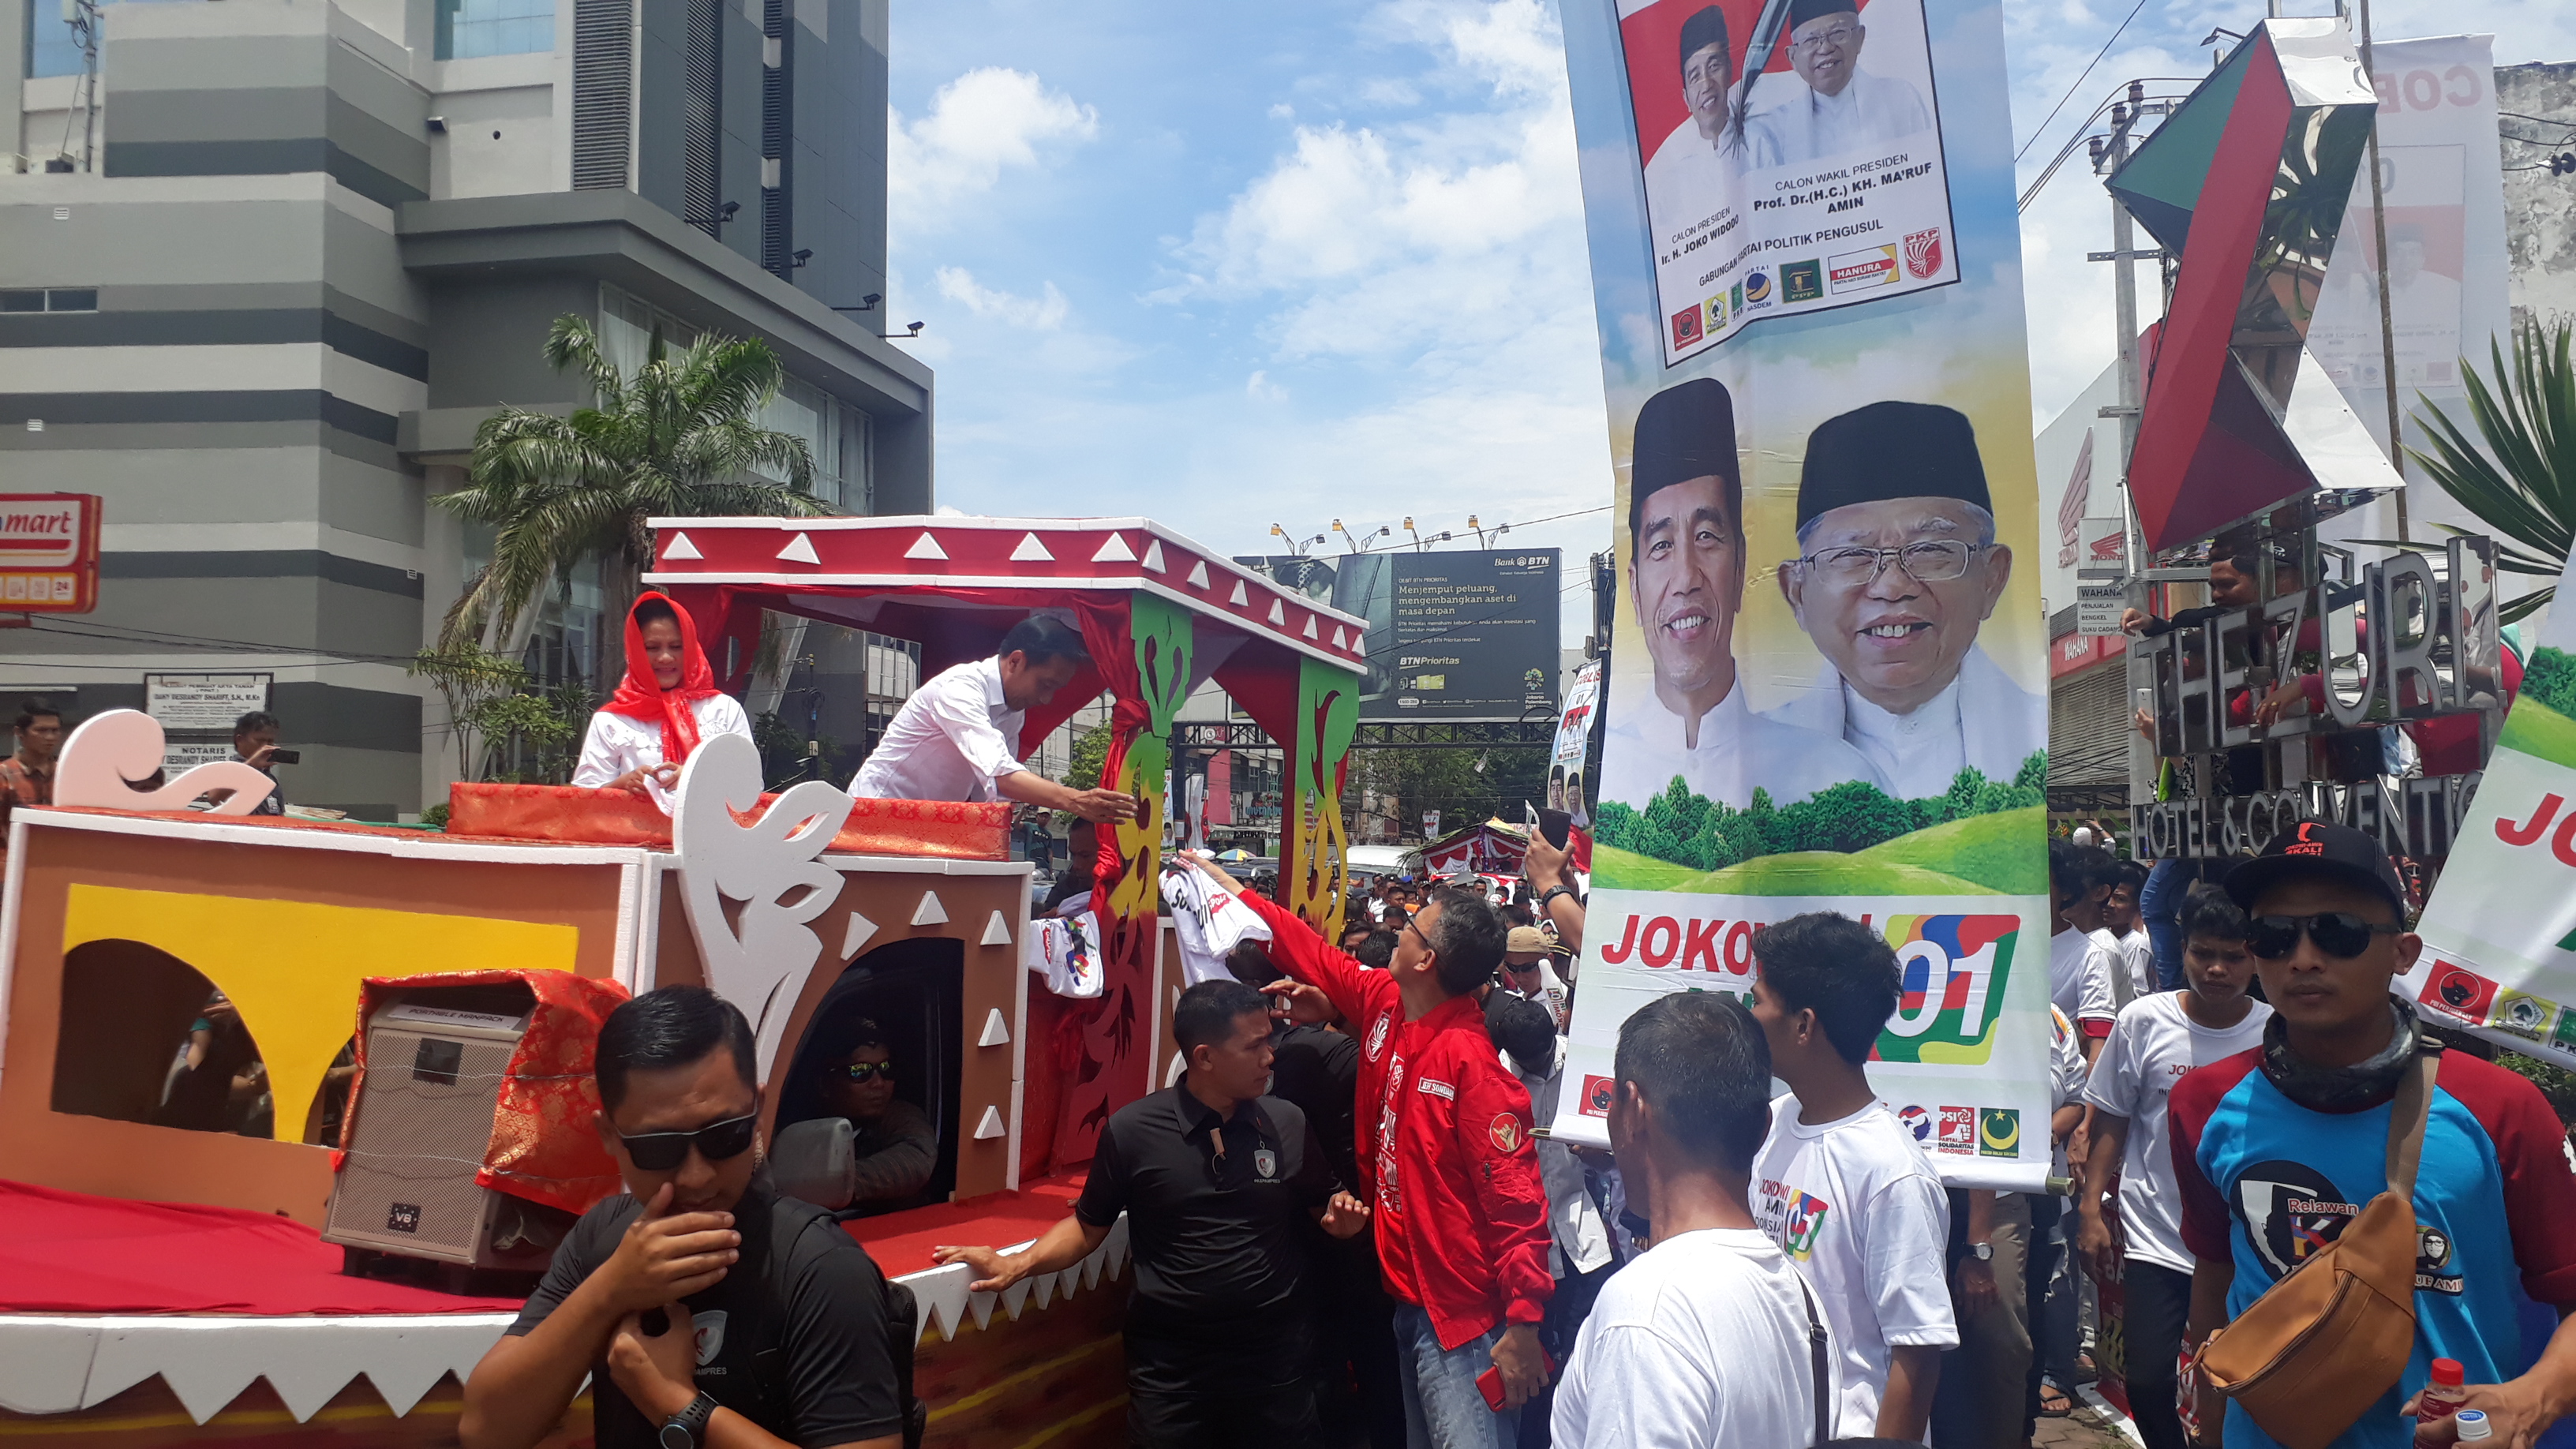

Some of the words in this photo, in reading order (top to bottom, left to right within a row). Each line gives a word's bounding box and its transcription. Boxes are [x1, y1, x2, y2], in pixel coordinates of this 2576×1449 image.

[1775, 176, 1814, 192] CALON
[1815, 168, 1851, 184] WAKIL
[1853, 153, 1909, 175] PRESIDEN
[1754, 197, 1786, 212] Prof.
[1790, 185, 1848, 206] Dr.(H.C.)
[1852, 178, 1877, 193] KH.
[1827, 197, 1864, 214] AMIN
[1672, 225, 1696, 245] CALON
[1698, 205, 1731, 232] PRESIDEN
[1661, 255, 1671, 265] Ir.
[1672, 249, 1682, 260] H.
[1683, 235, 1709, 254] JOKO
[1709, 214, 1739, 241] WIDODO
[1905, 229, 1938, 243] PKP
[1699, 256, 1738, 286] GABUNGAN
[1737, 242, 1762, 264] PARTAI
[1765, 233, 1813, 250] POLITIK
[1816, 219, 1884, 242] PENGUSUL
[1744, 264, 1769, 276] PARTAI
[1837, 262, 1882, 278] HANURA
[1747, 301, 1773, 313] NASDEM
[0, 511, 73, 534] mart
[1494, 557, 1515, 567] Bank
[1528, 556, 1550, 566] BTN
[55, 581, 69, 591] 24
[1398, 585, 1454, 596] Menjemput
[1456, 585, 1498, 593] peluang,
[2081, 589, 2123, 597] WAHANA
[1398, 595, 1483, 605] mengembangkan
[1507, 594, 1517, 603] di
[1425, 606, 1455, 616] depan
[2065, 635, 2088, 661] WAHANA
[2134, 609, 2262, 756] THE
[2264, 535, 2503, 739] ZURI
[2132, 797, 2218, 859] HOTEL
[2222, 794, 2242, 856] &
[1885, 938, 1998, 1038] 01
[408, 1009, 457, 1018] PORTABLE
[1939, 1111, 1957, 1123] PSI
[1938, 1147, 1975, 1156] INDONESIA
[2287, 1198, 2360, 1215] Relawan
[396, 1211, 412, 1223] V8
[695, 1367, 728, 1376] AMPRES
